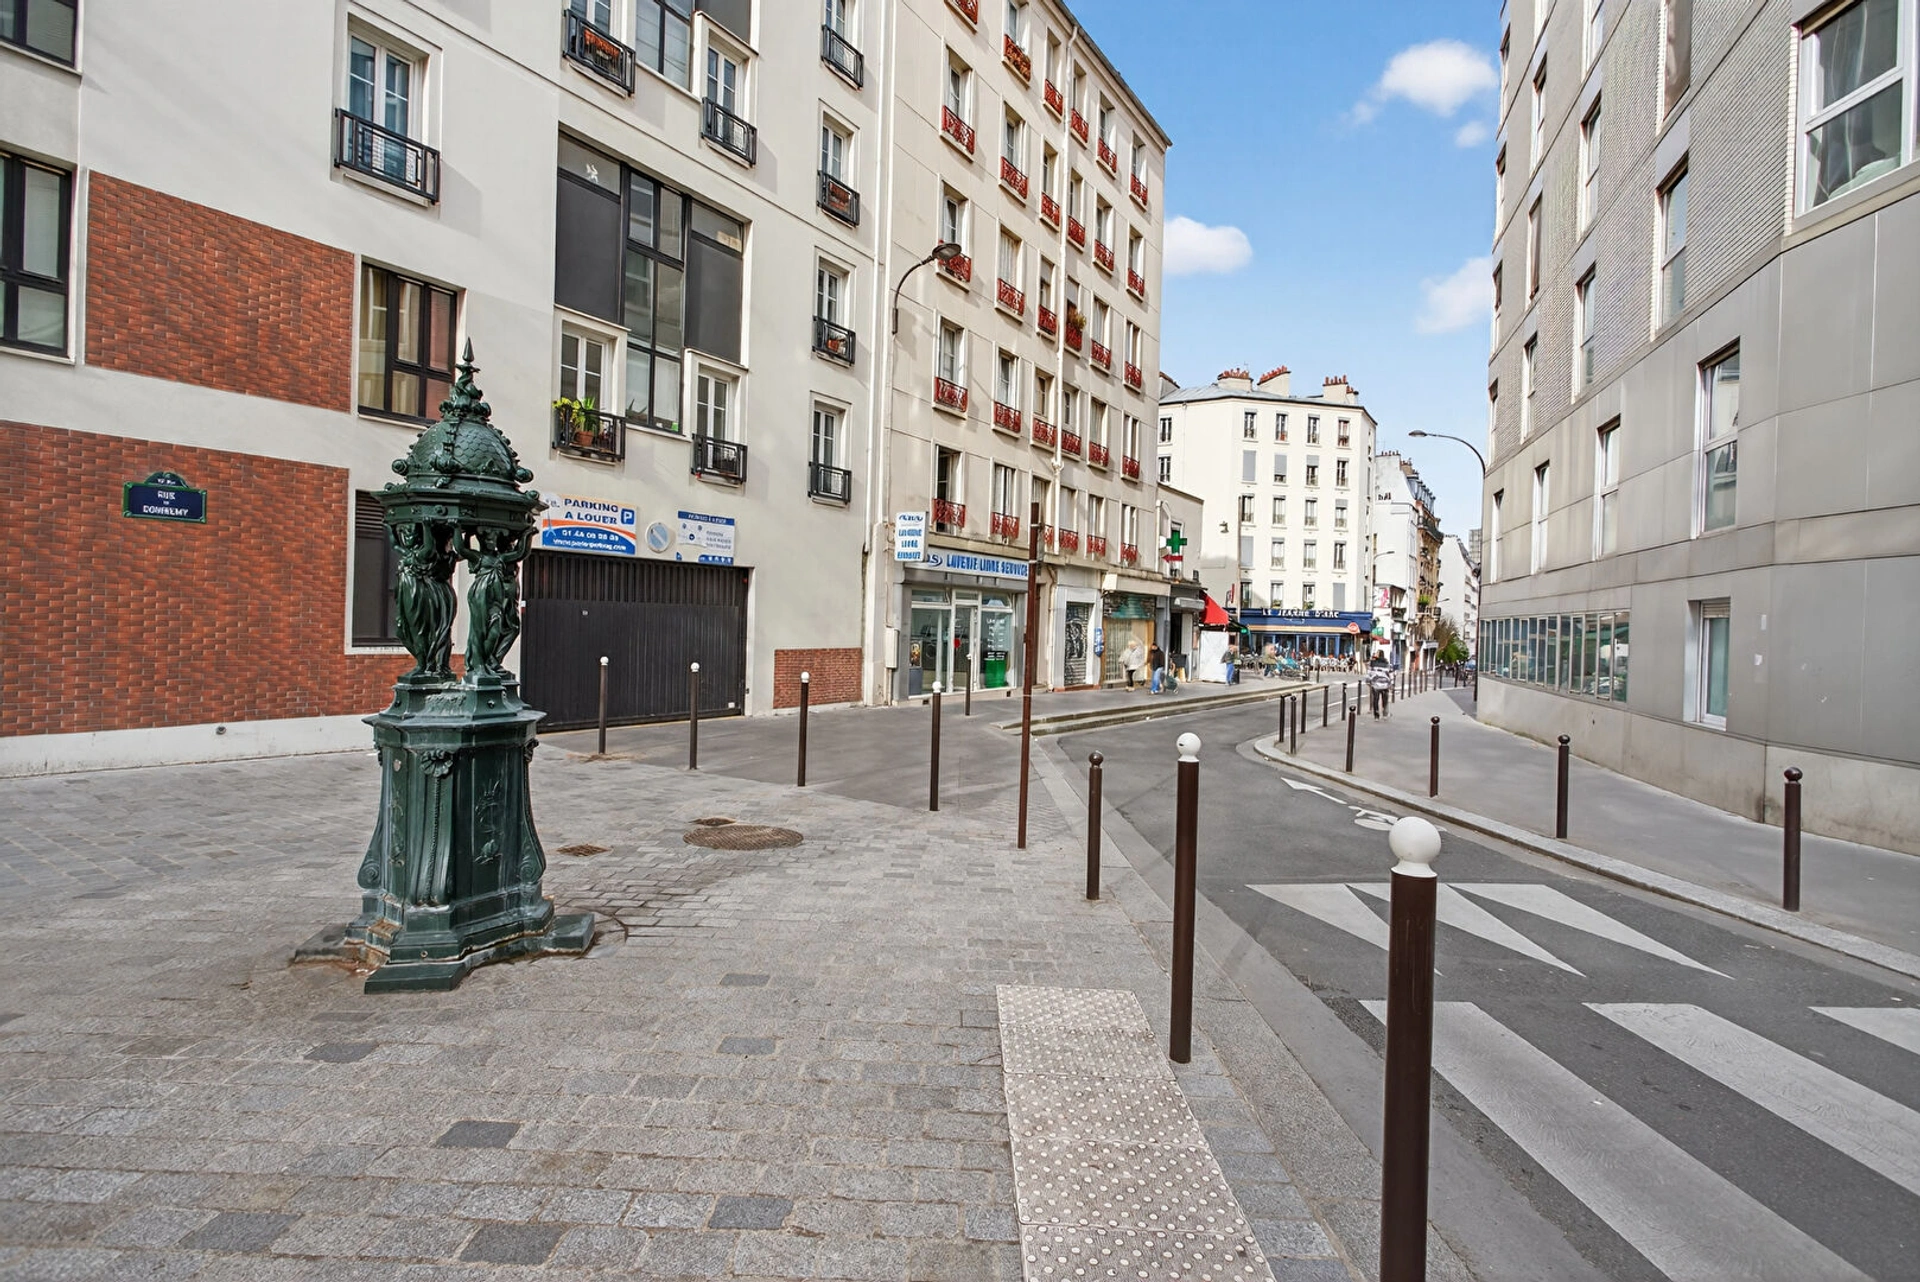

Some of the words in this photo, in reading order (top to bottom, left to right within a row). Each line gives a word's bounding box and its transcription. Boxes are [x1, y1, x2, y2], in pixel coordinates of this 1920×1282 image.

[157, 490, 176, 500] RUE
[564, 498, 619, 513] PARKING
[577, 512, 617, 525] LOUER
